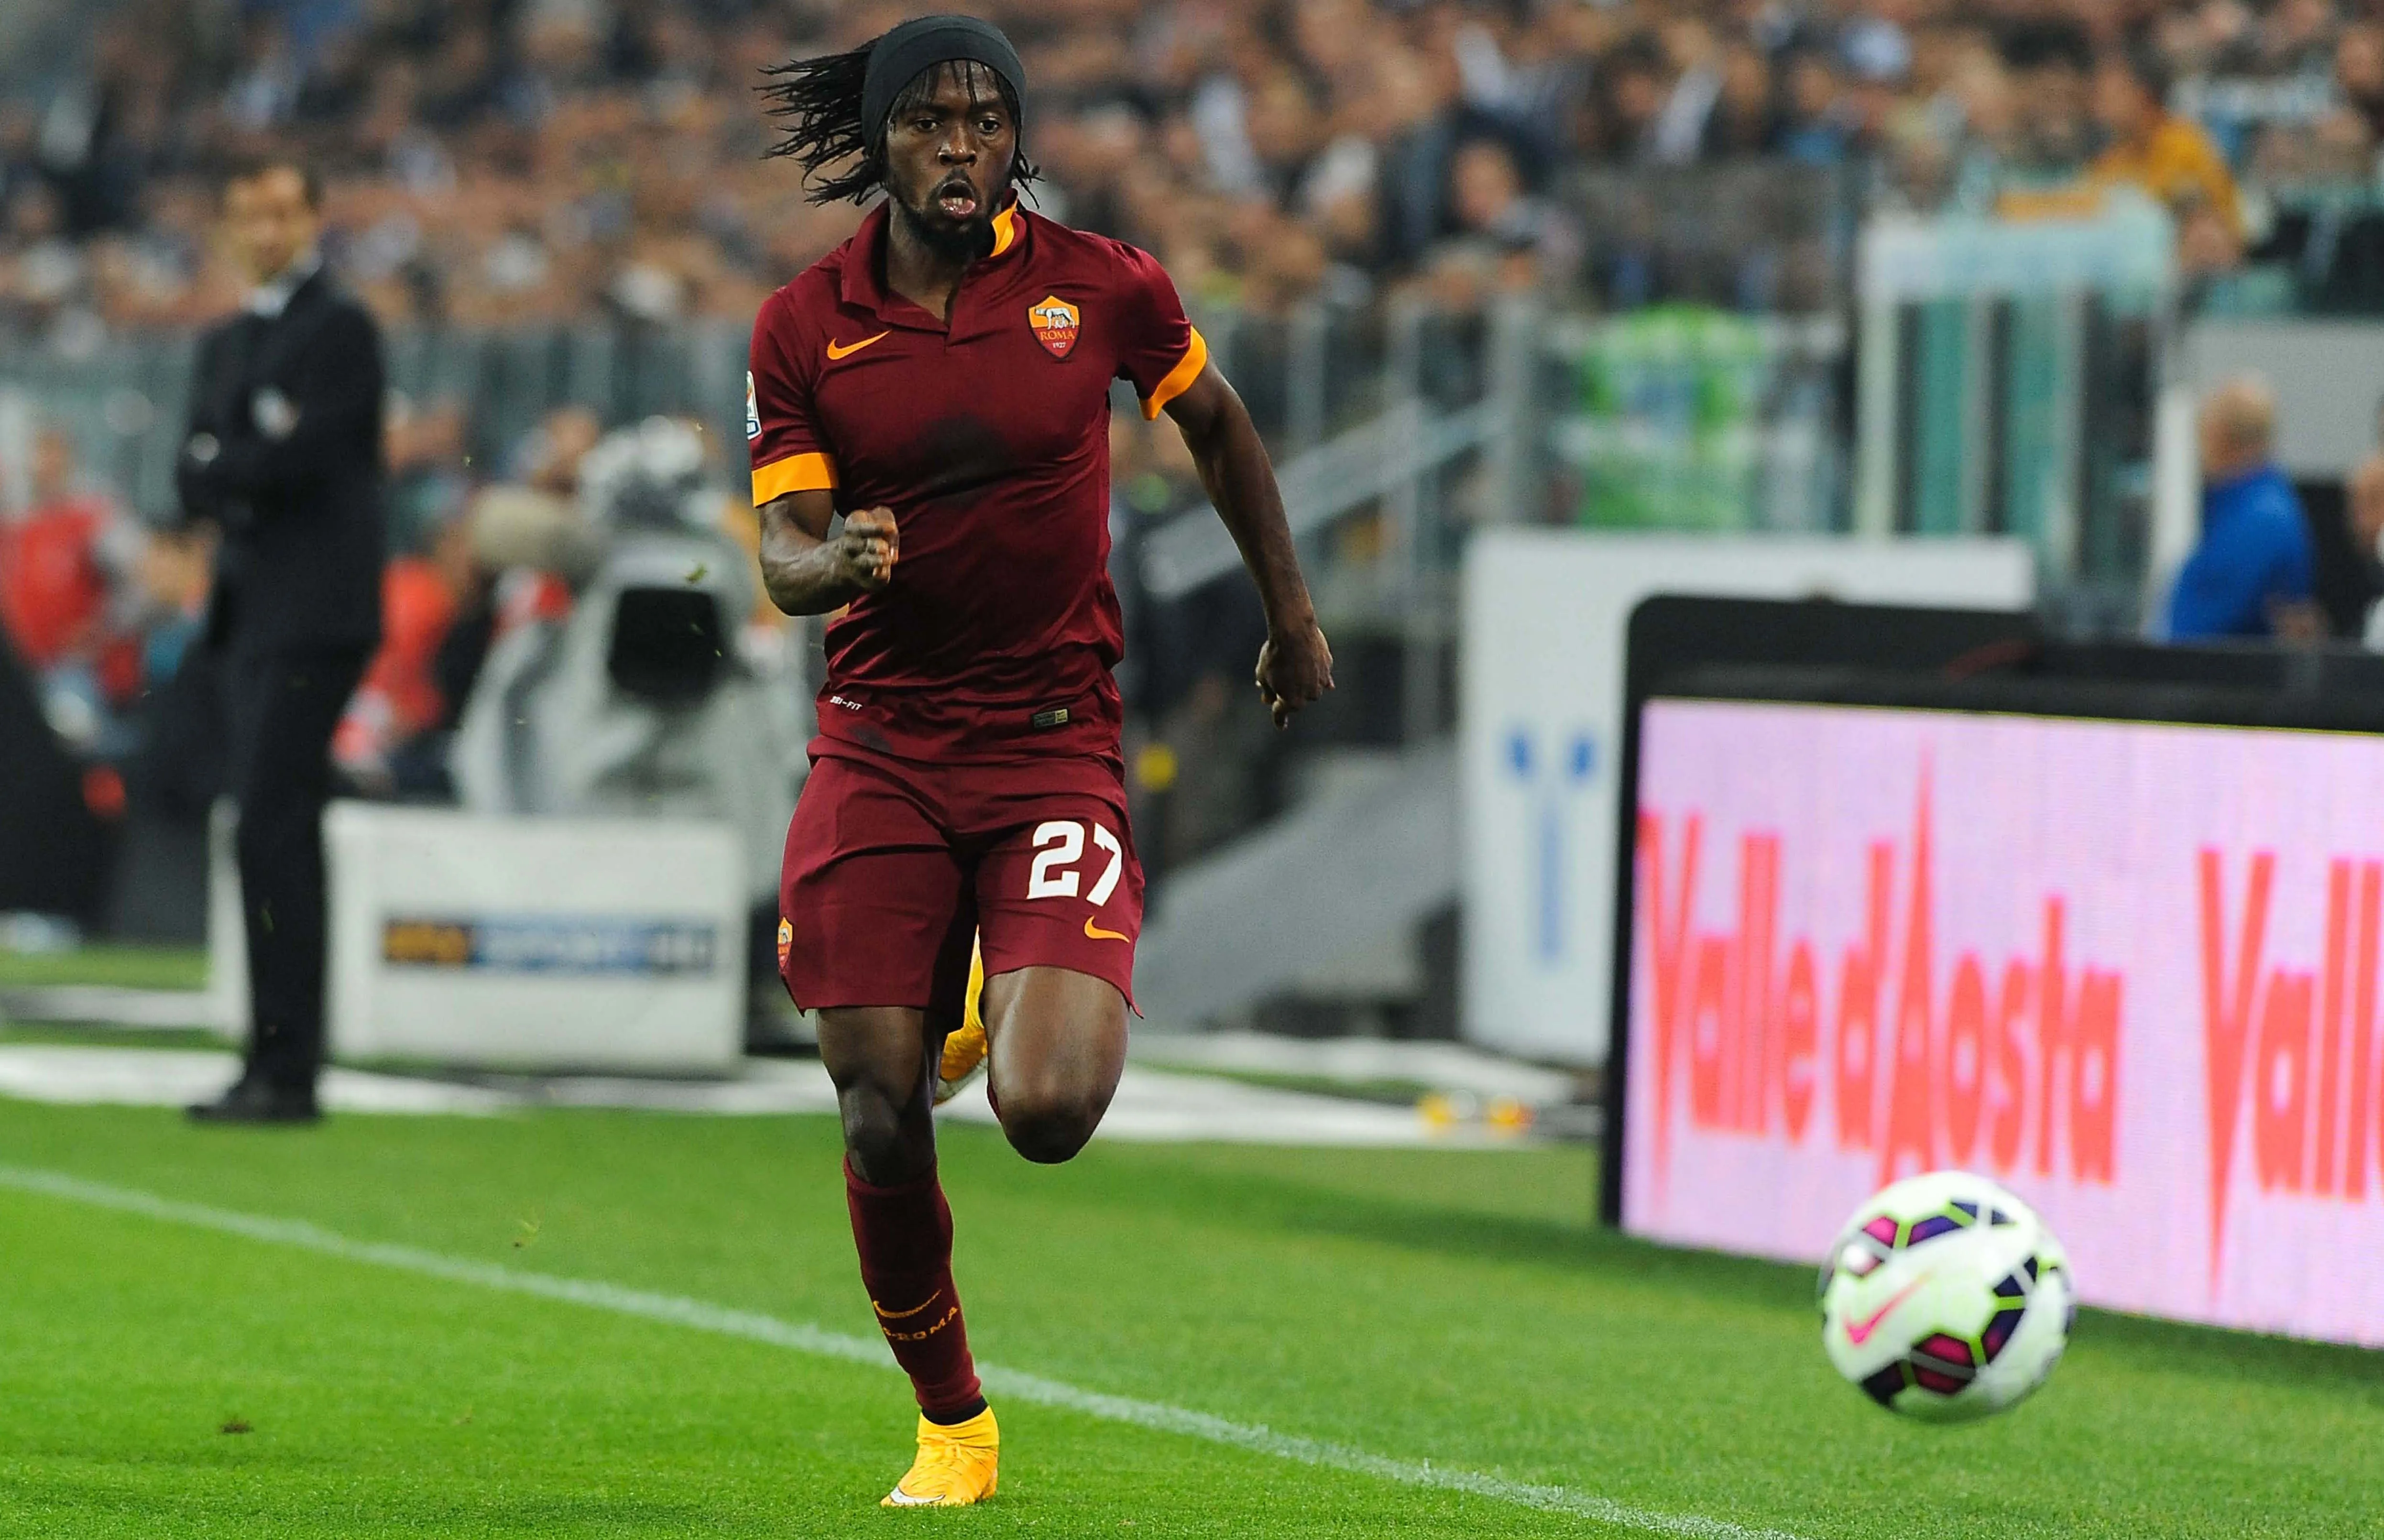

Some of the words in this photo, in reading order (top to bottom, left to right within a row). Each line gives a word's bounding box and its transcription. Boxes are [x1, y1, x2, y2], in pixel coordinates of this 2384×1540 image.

[1040, 330, 1075, 340] ROMA
[1027, 820, 1122, 907] 27
[1635, 810, 1820, 1217] Valle
[2198, 846, 2384, 1303] Vall
